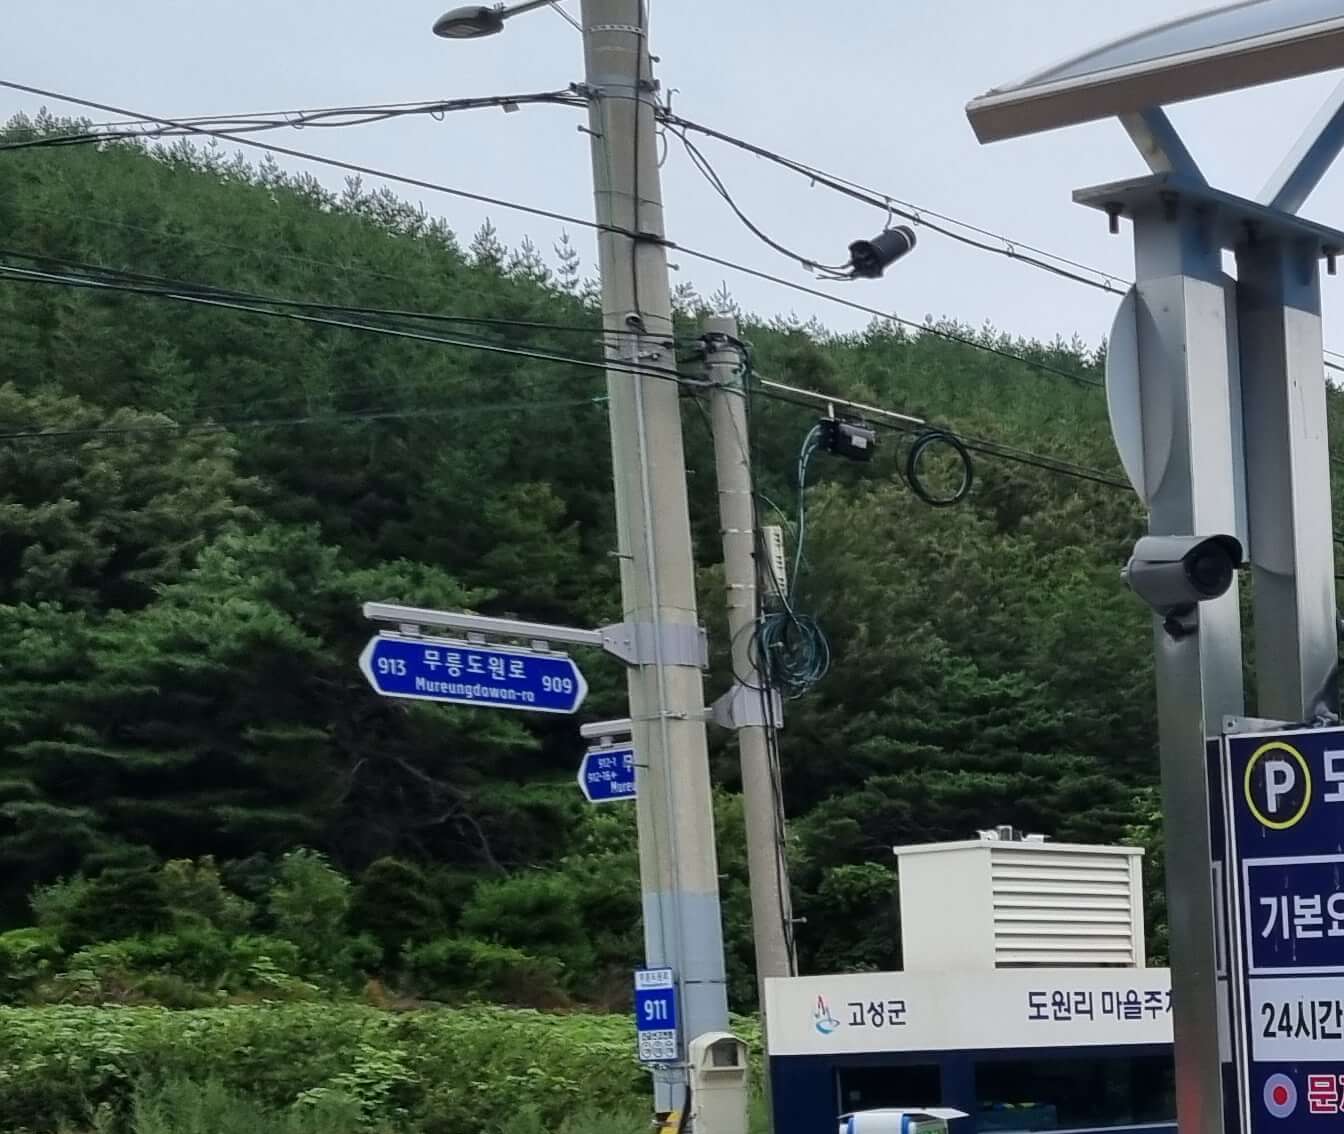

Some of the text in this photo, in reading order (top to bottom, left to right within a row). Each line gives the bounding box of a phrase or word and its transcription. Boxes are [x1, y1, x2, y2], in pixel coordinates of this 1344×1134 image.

[378, 659, 407, 676] 913
[423, 650, 527, 679] 무릉도원로
[416, 677, 534, 701] Mureungdowon-ro
[542, 677, 572, 693] 909
[1265, 760, 1295, 812] P
[644, 999, 668, 1020] 911
[848, 1000, 907, 1027] 고성군
[1028, 991, 1093, 1021] 도원리
[1262, 999, 1343, 1040] 24시간
